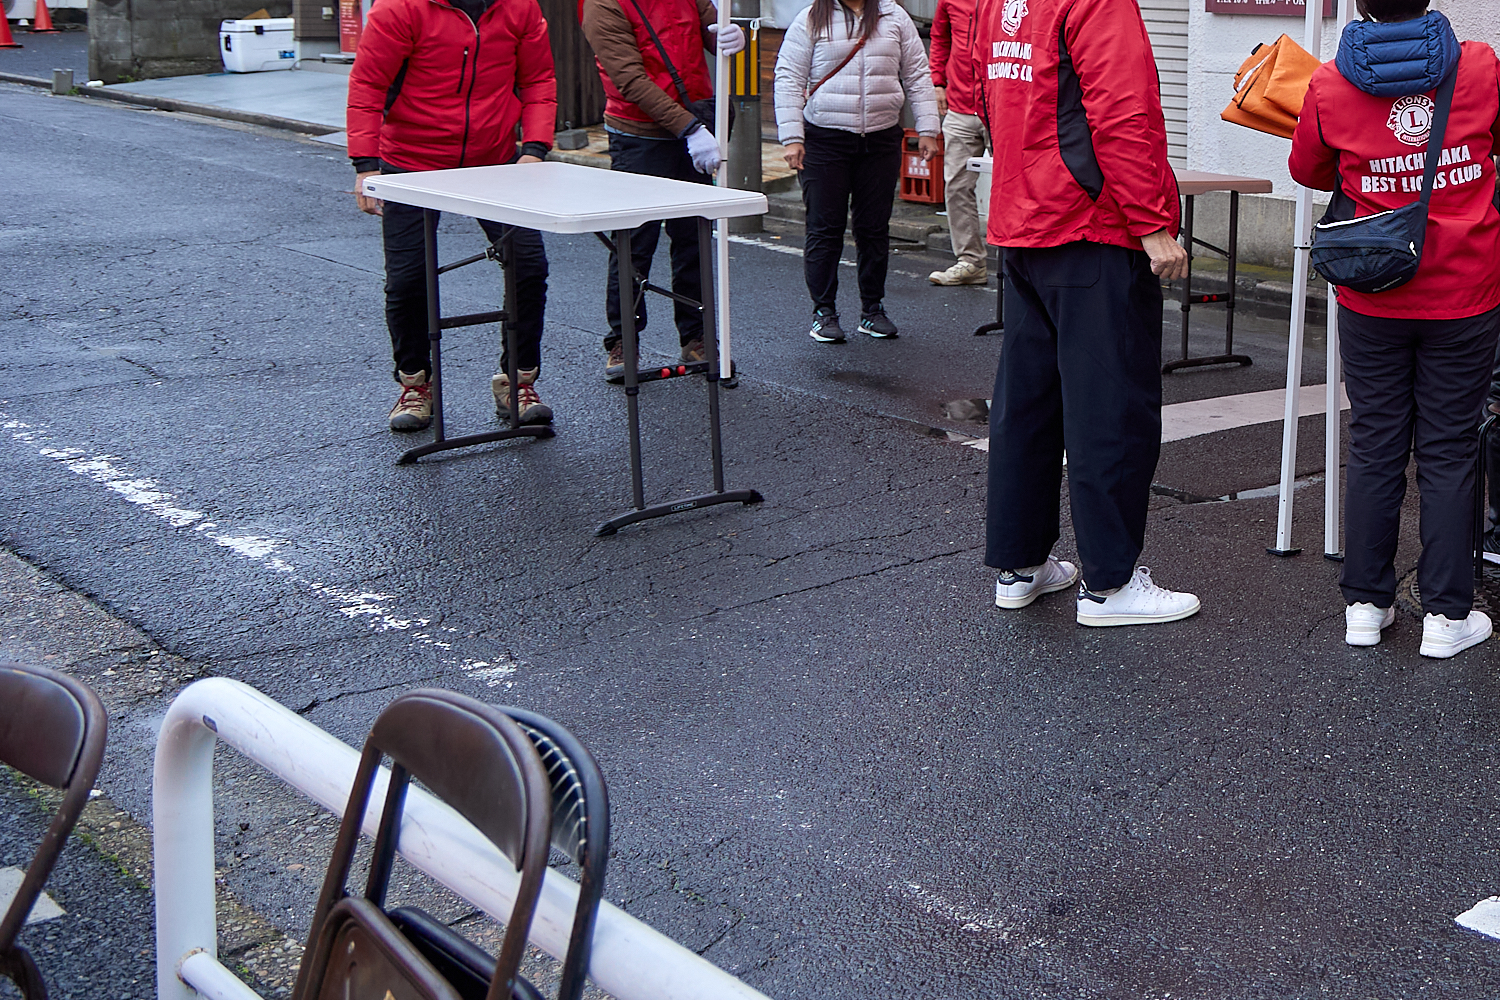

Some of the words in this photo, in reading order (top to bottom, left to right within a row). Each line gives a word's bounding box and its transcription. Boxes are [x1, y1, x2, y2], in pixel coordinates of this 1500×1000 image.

[1396, 96, 1430, 110] LIONS
[1407, 111, 1424, 129] L
[1361, 175, 1397, 193] BEST
[1449, 163, 1482, 186] CLUB
